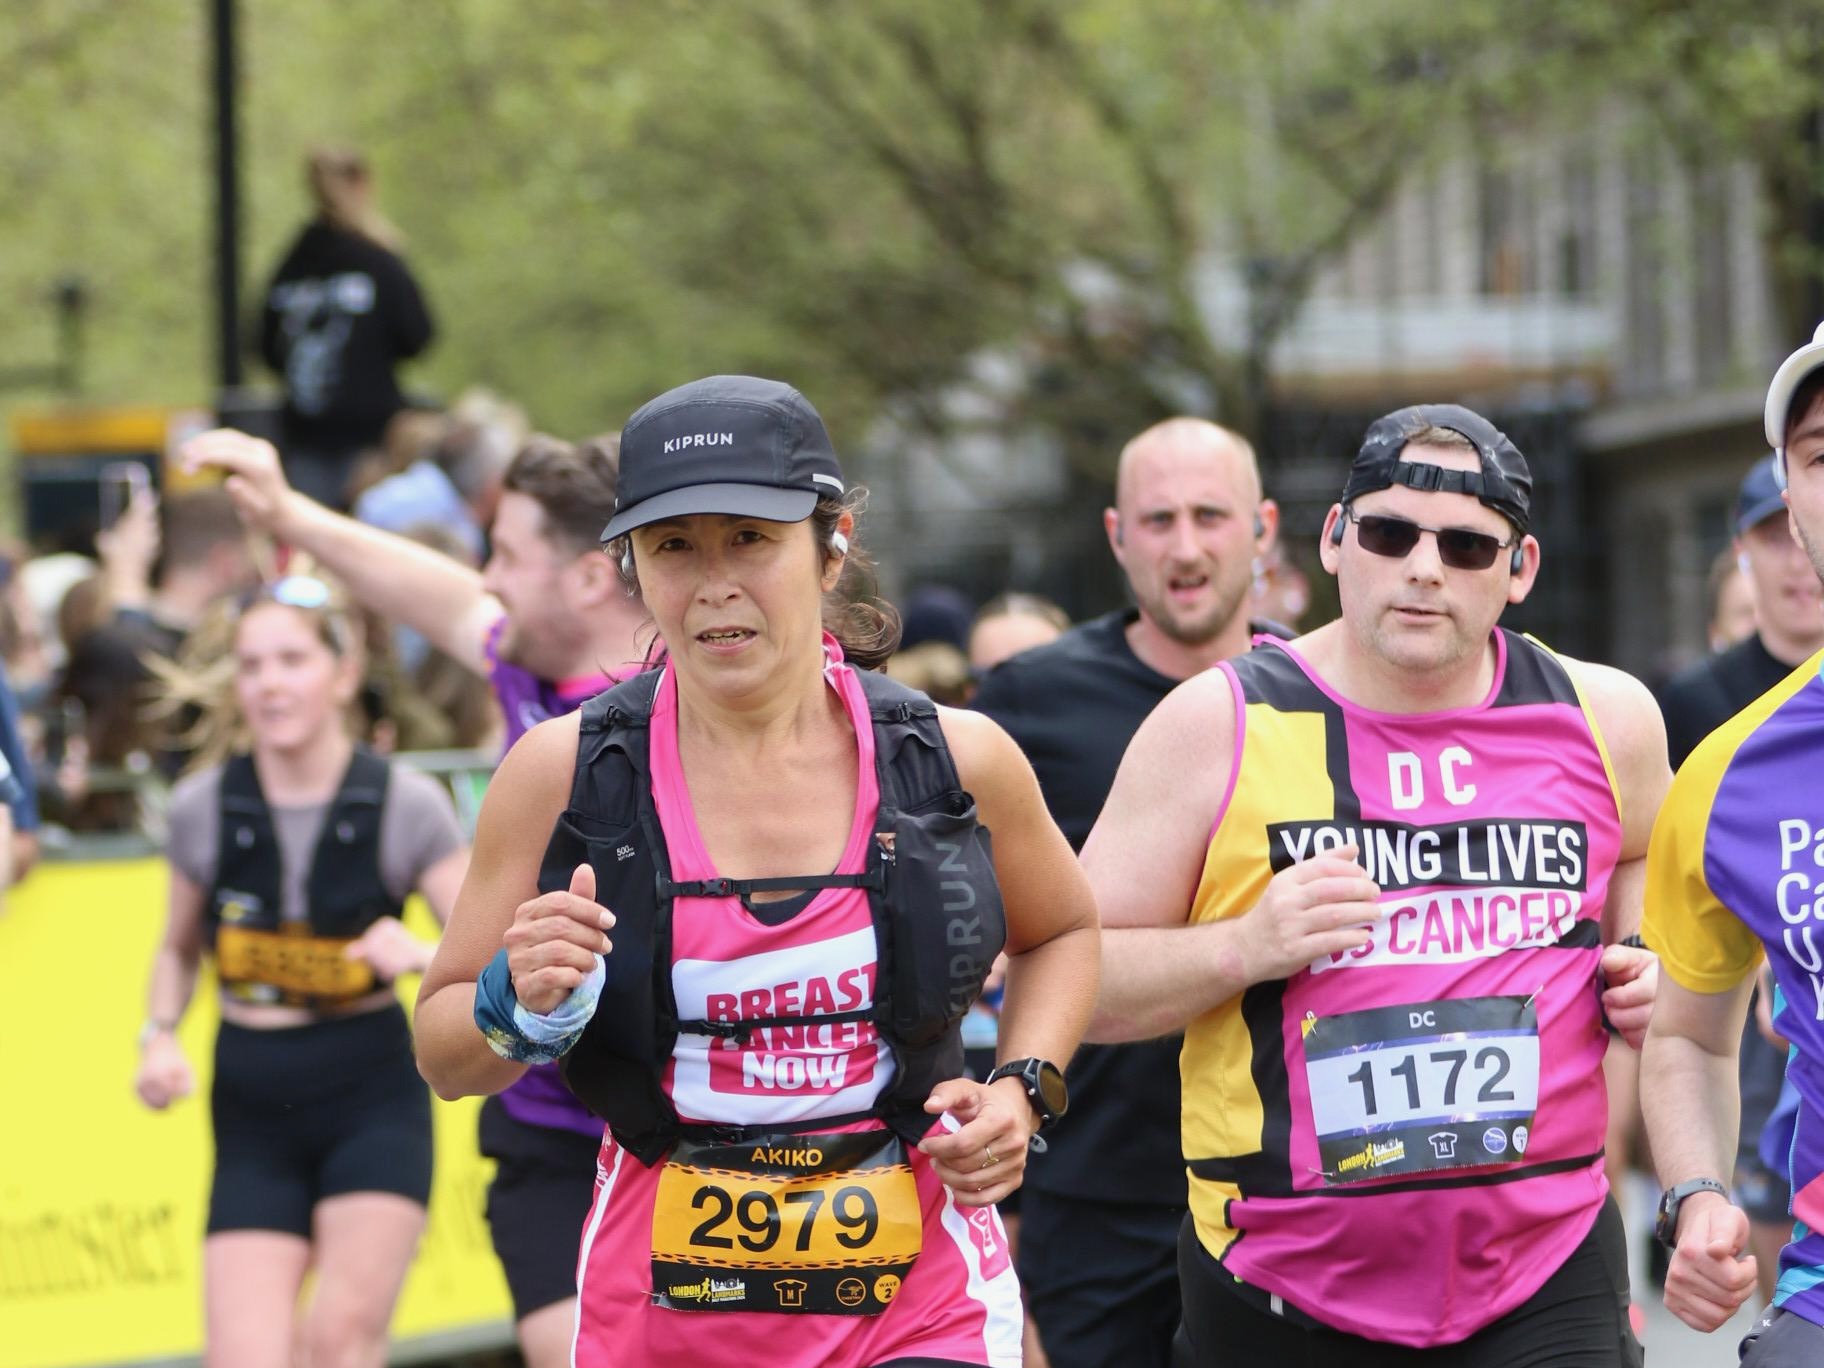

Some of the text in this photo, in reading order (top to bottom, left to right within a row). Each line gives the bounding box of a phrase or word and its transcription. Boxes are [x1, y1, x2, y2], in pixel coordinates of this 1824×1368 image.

[664, 432, 733, 454] KIPRUN
[1279, 823, 1582, 886] YOUNG LIVES
[1388, 891, 1572, 955] CANCER
[707, 961, 878, 1022] BREAST
[1408, 1011, 1436, 1029] DC
[743, 1052, 850, 1090] NOW
[1347, 1046, 1515, 1116] 1172
[751, 1147, 823, 1167] AKIKO
[1439, 1141, 1449, 1153] XL
[1338, 1151, 1366, 1172] LONDON
[688, 1185, 879, 1252] 2979
[668, 1284, 701, 1297] LONDON
[786, 1289, 794, 1300] M
[884, 1288, 892, 1299] 2
